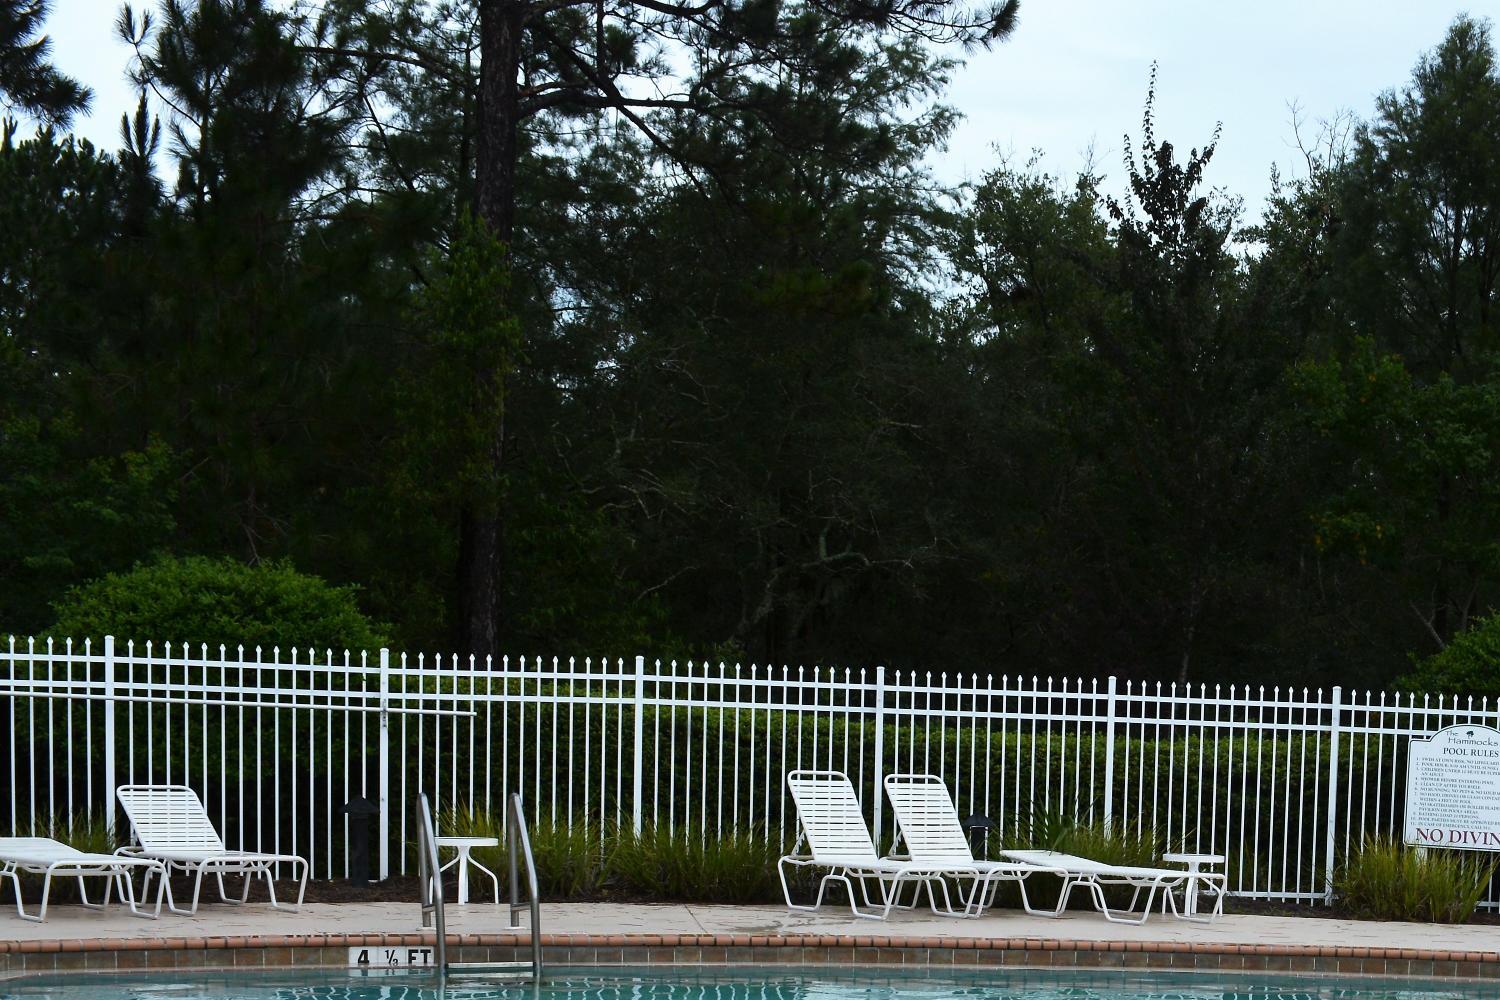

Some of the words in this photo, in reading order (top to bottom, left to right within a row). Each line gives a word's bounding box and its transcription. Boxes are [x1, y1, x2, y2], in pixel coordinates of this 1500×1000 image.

[1448, 737, 1499, 747] Hammocks
[1443, 747, 1469, 756] POOL
[1470, 748, 1499, 758] RULES
[1415, 827, 1444, 843] NO
[357, 949, 370, 964] 4
[408, 949, 431, 964] FT
